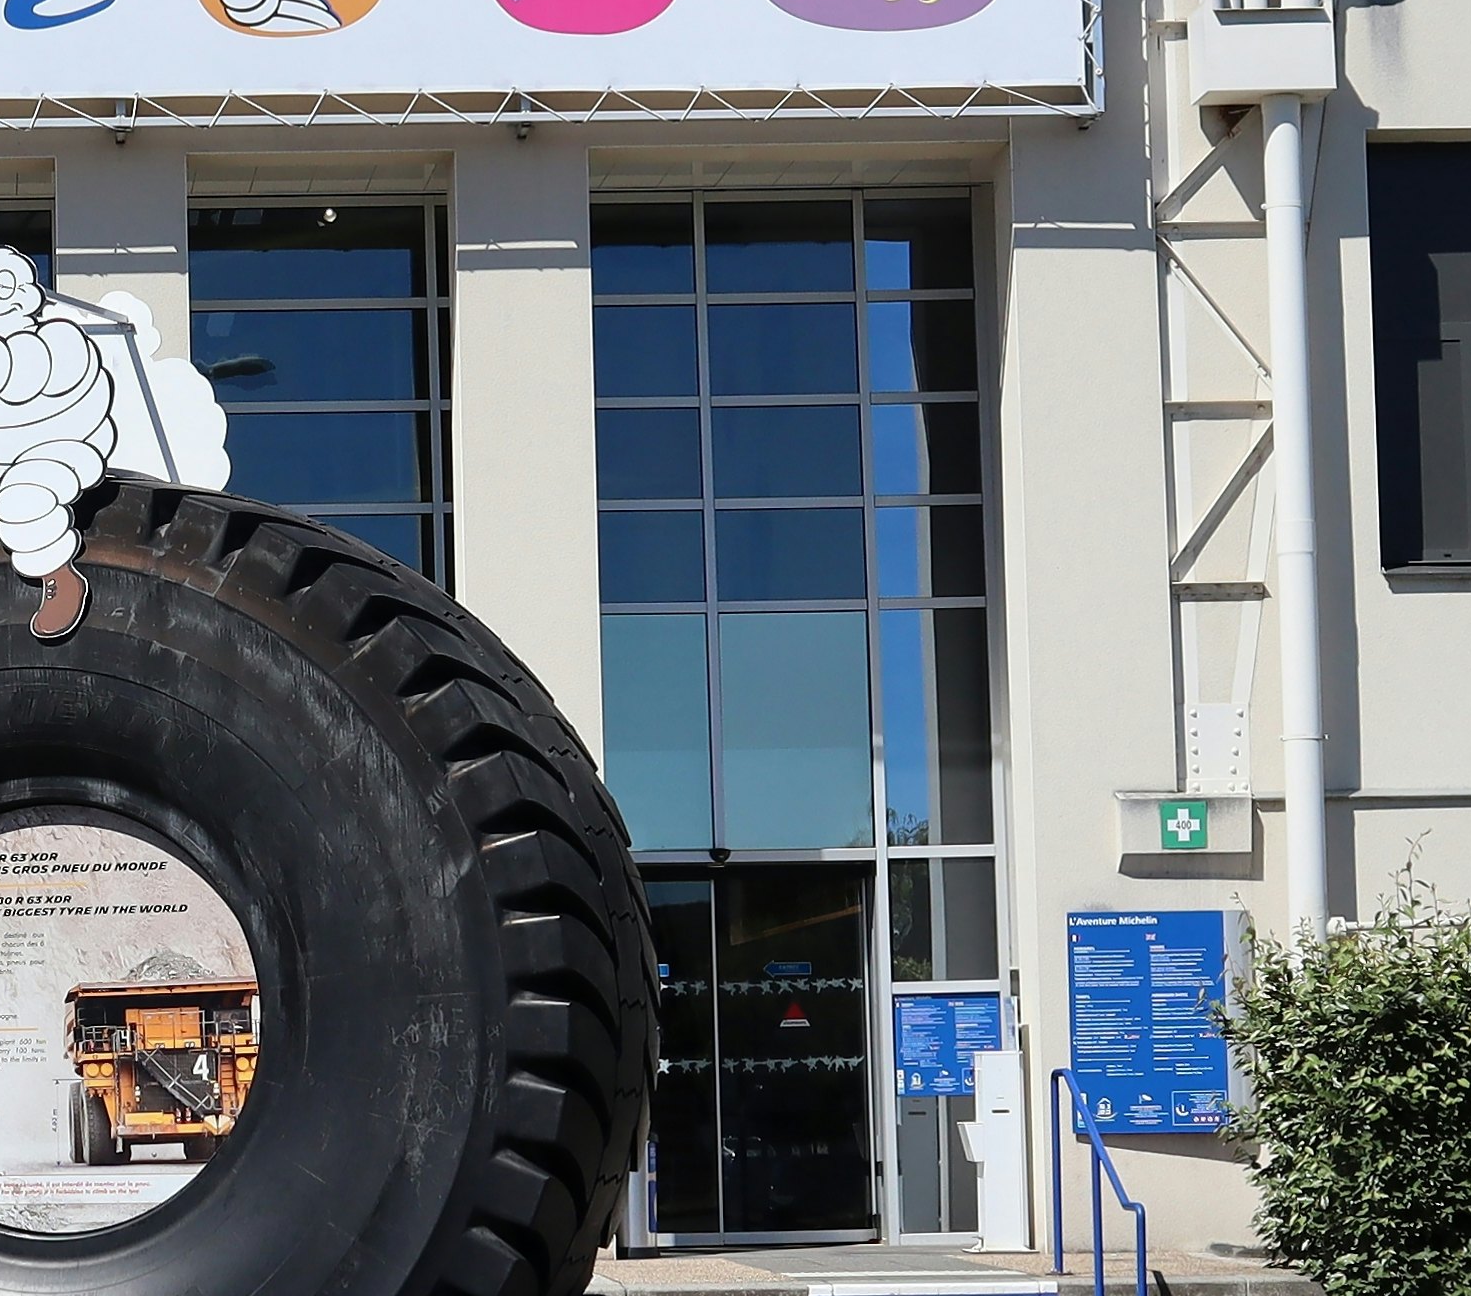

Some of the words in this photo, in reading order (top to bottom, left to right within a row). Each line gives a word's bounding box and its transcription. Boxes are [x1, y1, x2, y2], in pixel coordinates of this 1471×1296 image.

[1175, 819, 1192, 831] 400
[10, 854, 26, 862] 63
[30, 853, 58, 862] XDR
[12, 865, 48, 874] GROS
[51, 864, 90, 873] PNEU
[92, 863, 112, 872] DU
[114, 862, 167, 871] MONDE
[15, 896, 24, 904] R
[27, 896, 42, 904] 63
[45, 895, 72, 904] XDR
[3, 908, 56, 917] BIGGEST
[59, 907, 93, 916] TYRE
[95, 906, 109, 915] IN
[113, 905, 135, 914] THE
[139, 904, 188, 913] WORLD
[1069, 917, 1116, 926] L'Aventure
[1119, 916, 1158, 925] Michelin
[193, 1054, 209, 1081] 4
